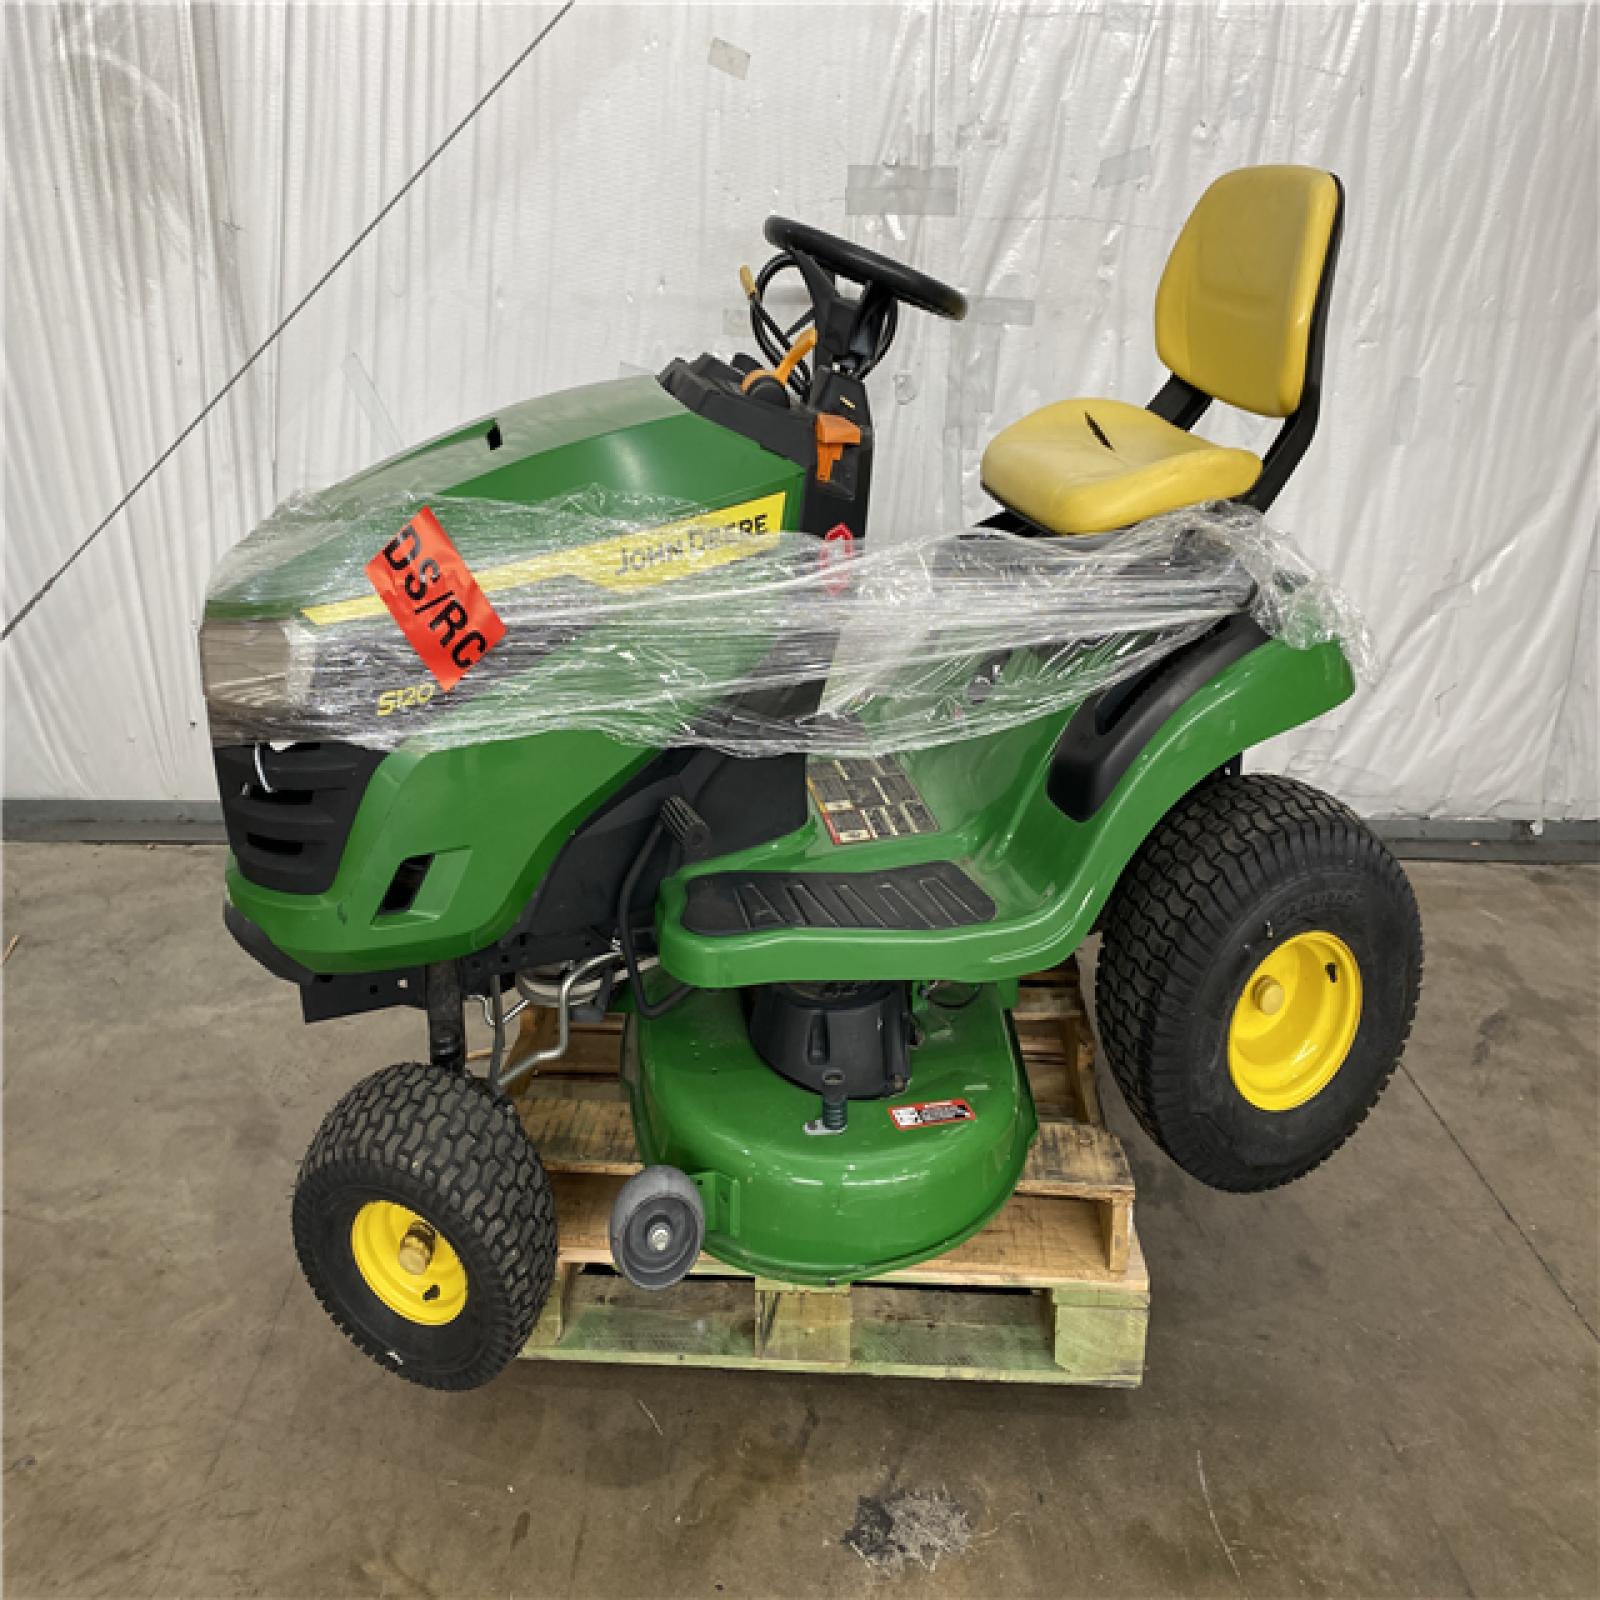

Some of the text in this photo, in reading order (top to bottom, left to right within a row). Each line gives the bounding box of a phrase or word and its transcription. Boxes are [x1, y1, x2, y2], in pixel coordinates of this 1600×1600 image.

[615, 512, 768, 576] JOHN DEERE
[382, 524, 487, 669] DS/RC
[376, 682, 436, 717] S120
